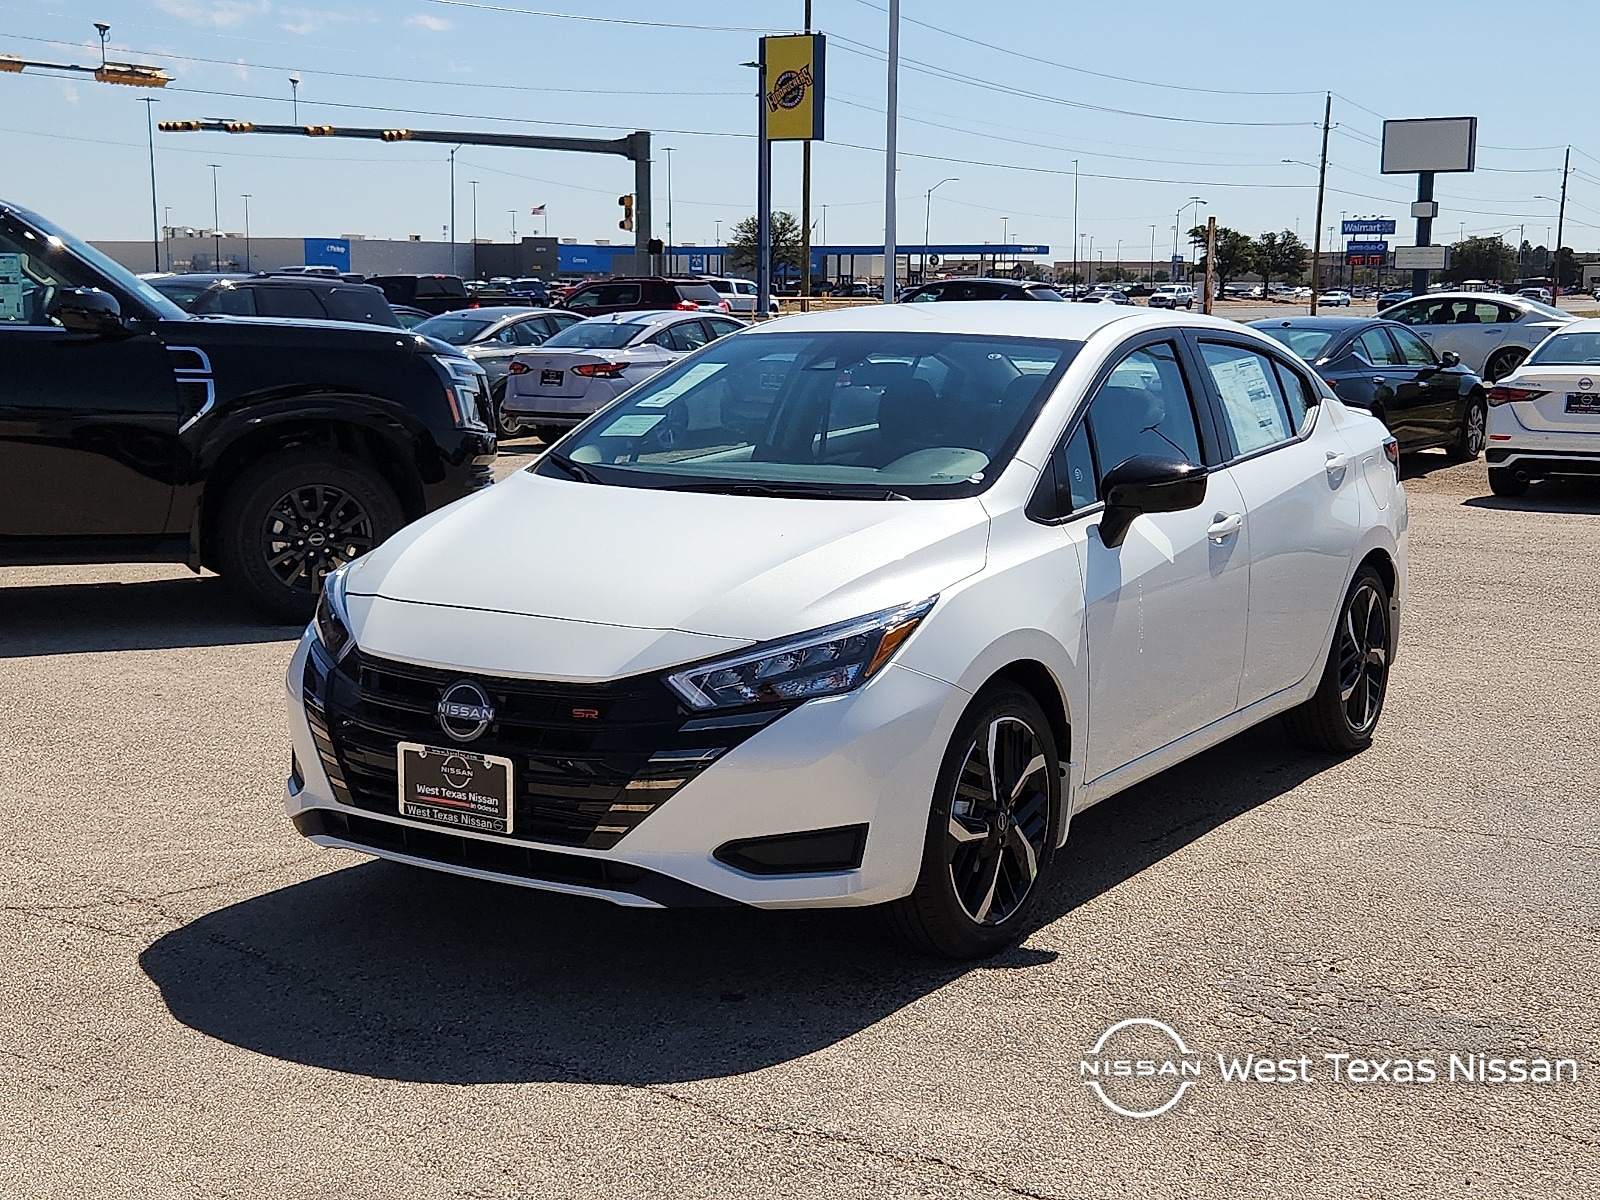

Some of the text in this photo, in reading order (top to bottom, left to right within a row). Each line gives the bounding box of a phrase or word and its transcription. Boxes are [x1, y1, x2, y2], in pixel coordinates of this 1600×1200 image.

[1344, 223, 1381, 232] Walmart
[437, 701, 493, 721] NISSAN
[572, 708, 599, 719] SR
[441, 766, 473, 777] NISSAN
[416, 784, 499, 806] West Texas Nissan
[477, 804, 499, 813] Odessa
[407, 805, 493, 829] West Texas Nissan
